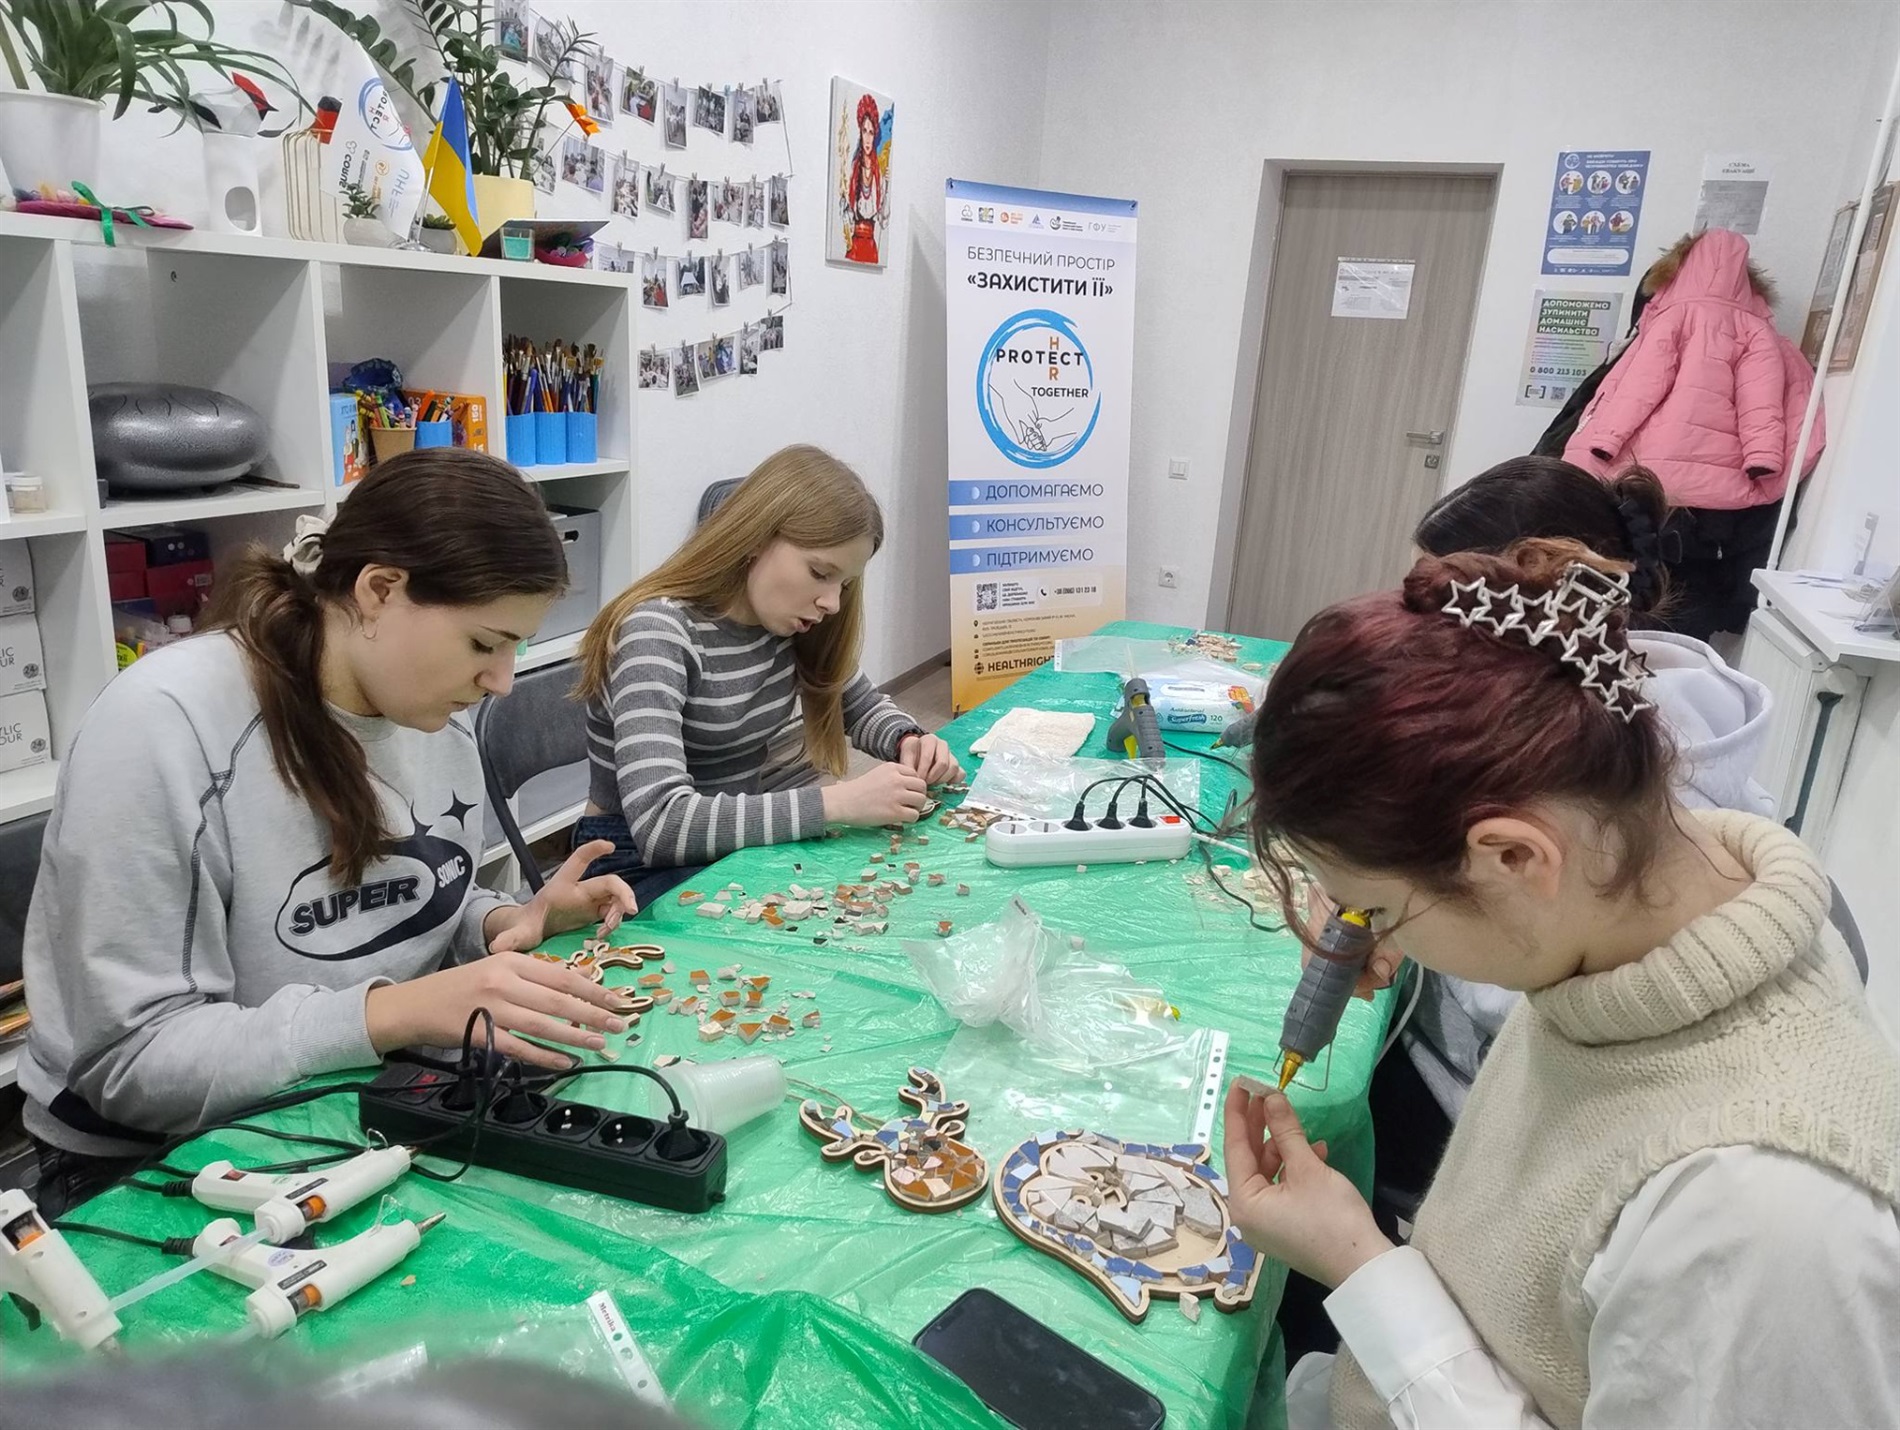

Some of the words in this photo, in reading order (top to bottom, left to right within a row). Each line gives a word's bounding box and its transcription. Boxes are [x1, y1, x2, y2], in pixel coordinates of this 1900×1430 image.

[967, 246, 1053, 267] БЕЗПЕЧНИЙ
[1057, 254, 1115, 271] ПРОСТІР
[967, 272, 1087, 297] «ЗАХИСТИТИ
[1092, 277, 1113, 298] ЇЇ»
[1543, 299, 1609, 309] ДОПОМОЖЕМО
[1542, 309, 1588, 317] ЗУПИНИТИ
[1539, 327, 1598, 335] НАСИЛЬСТВО
[996, 349, 1084, 366] PROTECT
[1031, 387, 1089, 399] TOGETHER
[986, 483, 1104, 500] ДОПОМАГАЄМО
[987, 515, 1104, 533] КОНСУЛЬТУЄМО
[987, 548, 1094, 568] ПІДТРИМУЄМО
[988, 655, 1055, 672] HEALTHRIGH
[1210, 714, 1223, 722] 120
[437, 855, 466, 888] SONIC
[288, 874, 422, 936] SUPER
[598, 1302, 616, 1332] Metrika
